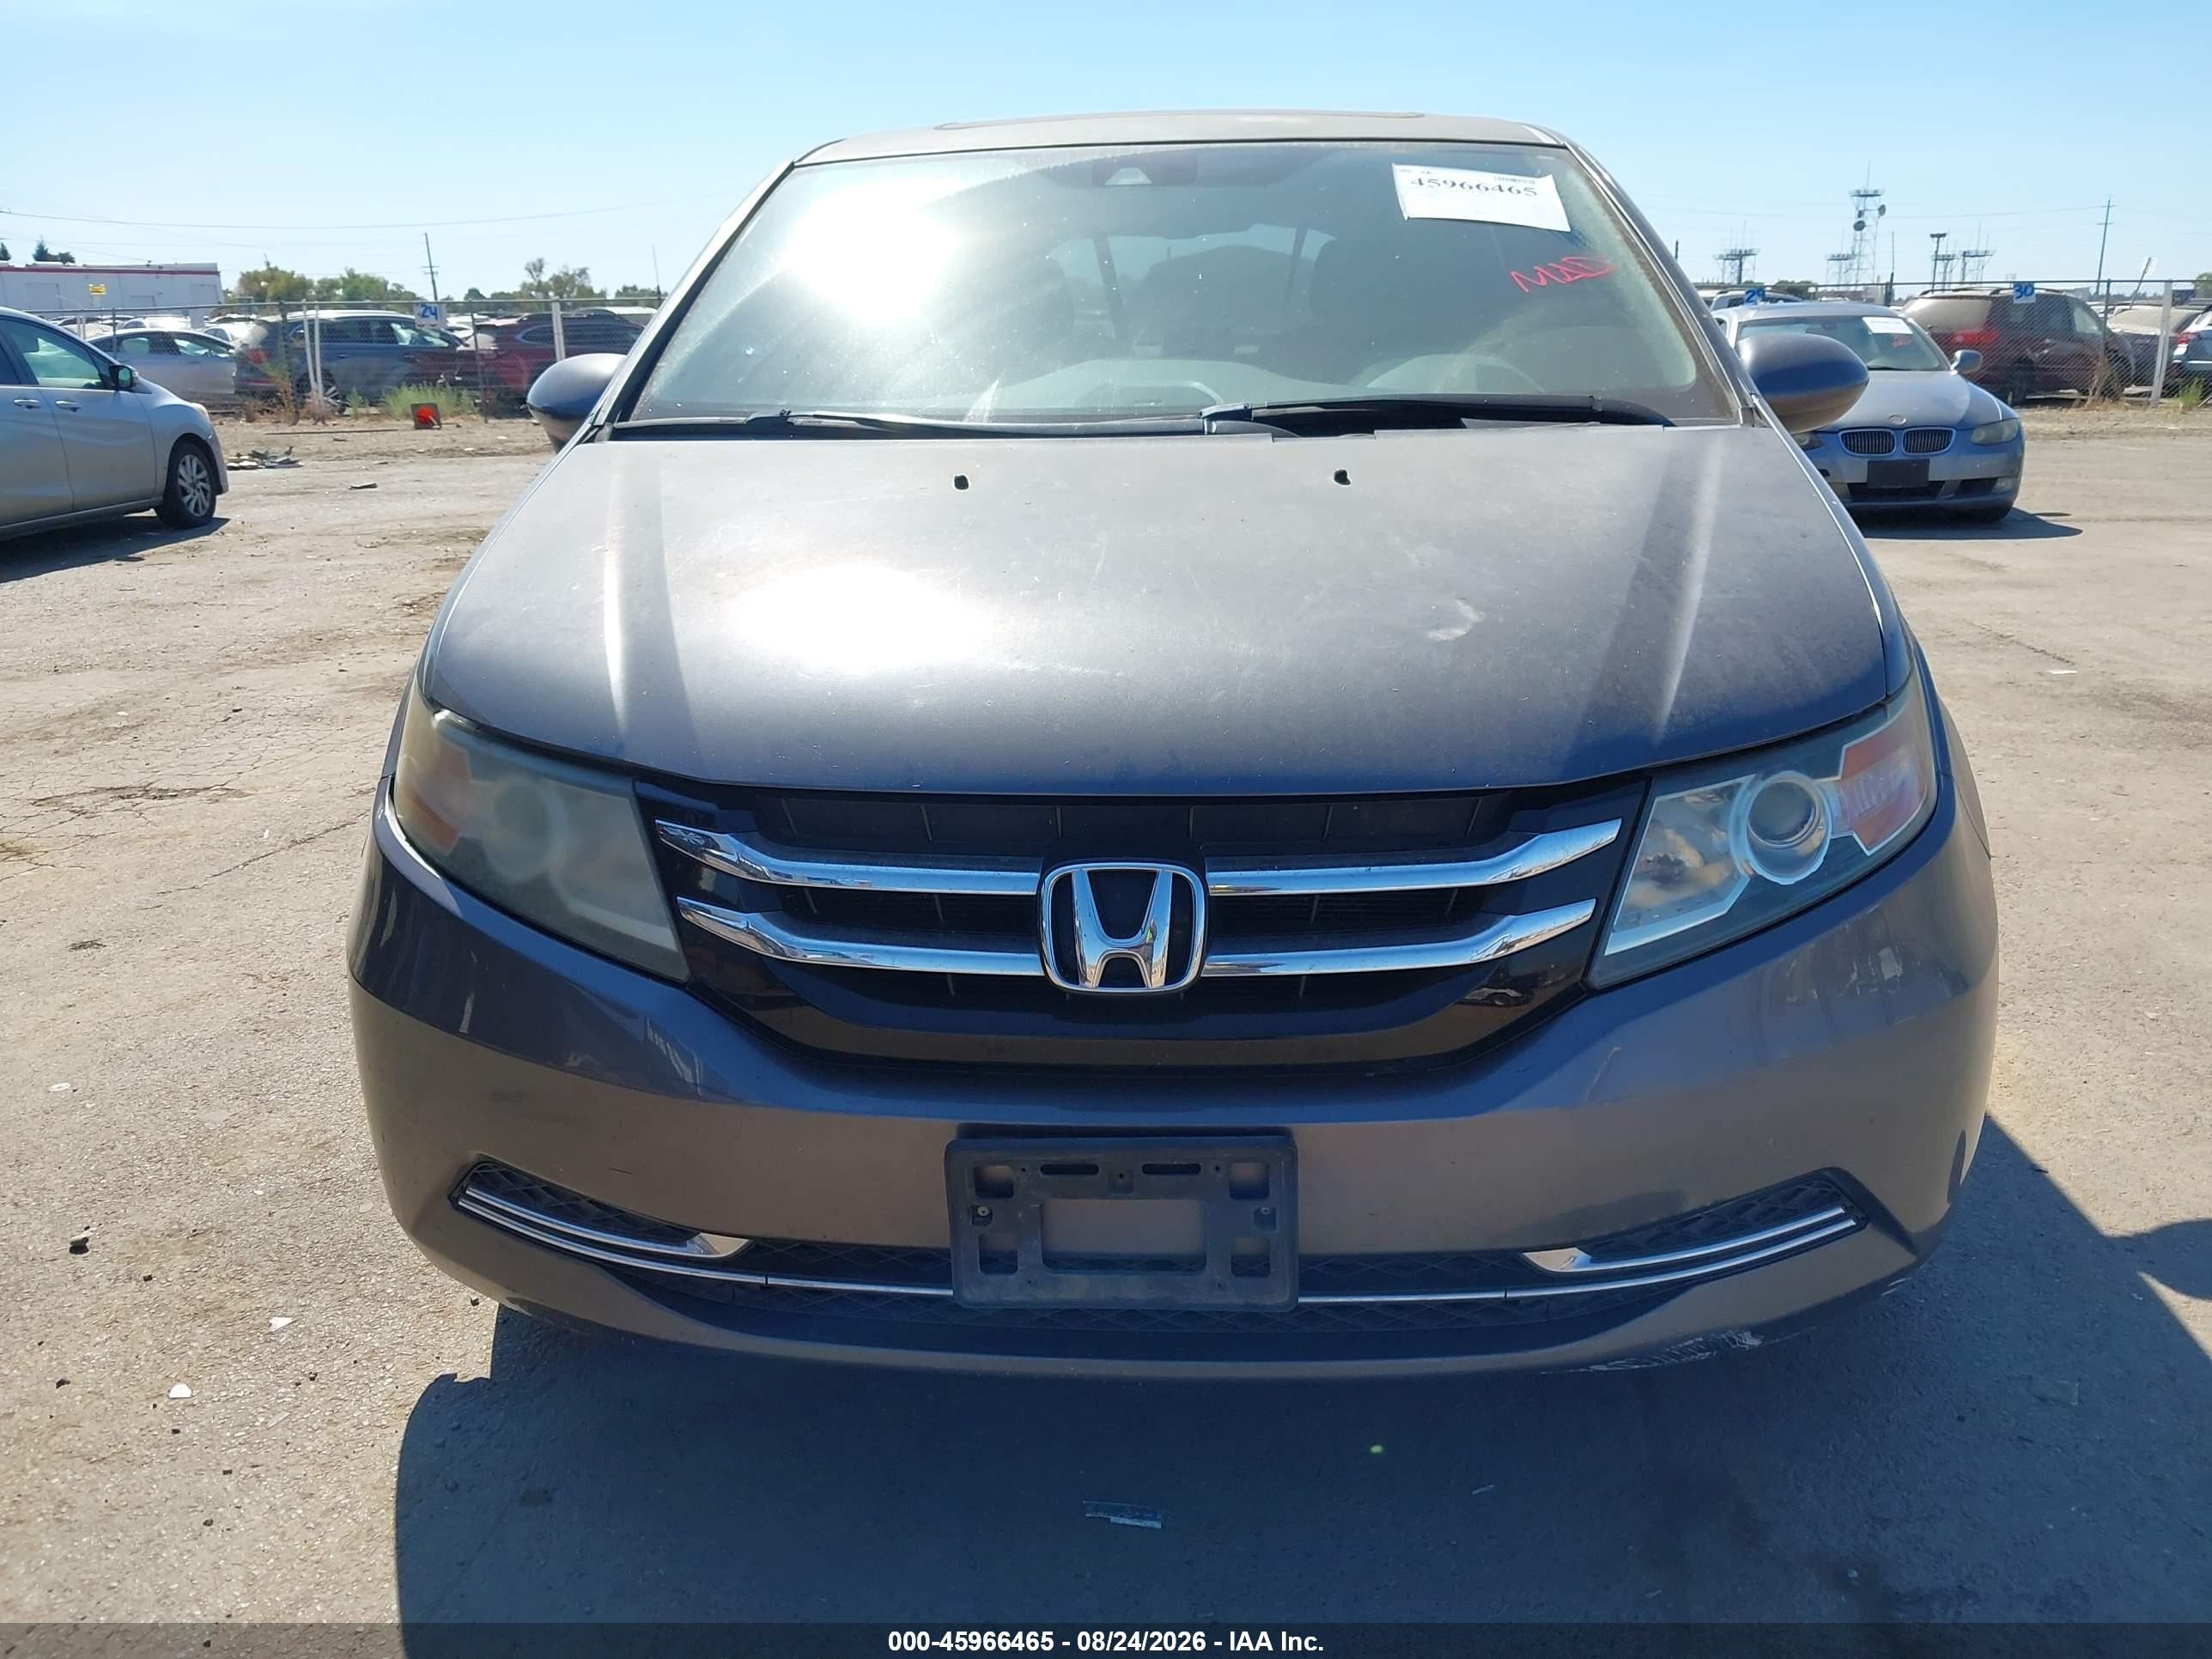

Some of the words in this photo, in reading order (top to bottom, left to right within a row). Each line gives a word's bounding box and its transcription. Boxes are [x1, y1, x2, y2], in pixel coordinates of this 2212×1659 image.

[1410, 177, 1538, 197] 45966465
[1745, 288, 1765, 304] 29
[2013, 283, 2035, 300] 30
[420, 302, 439, 321] 24
